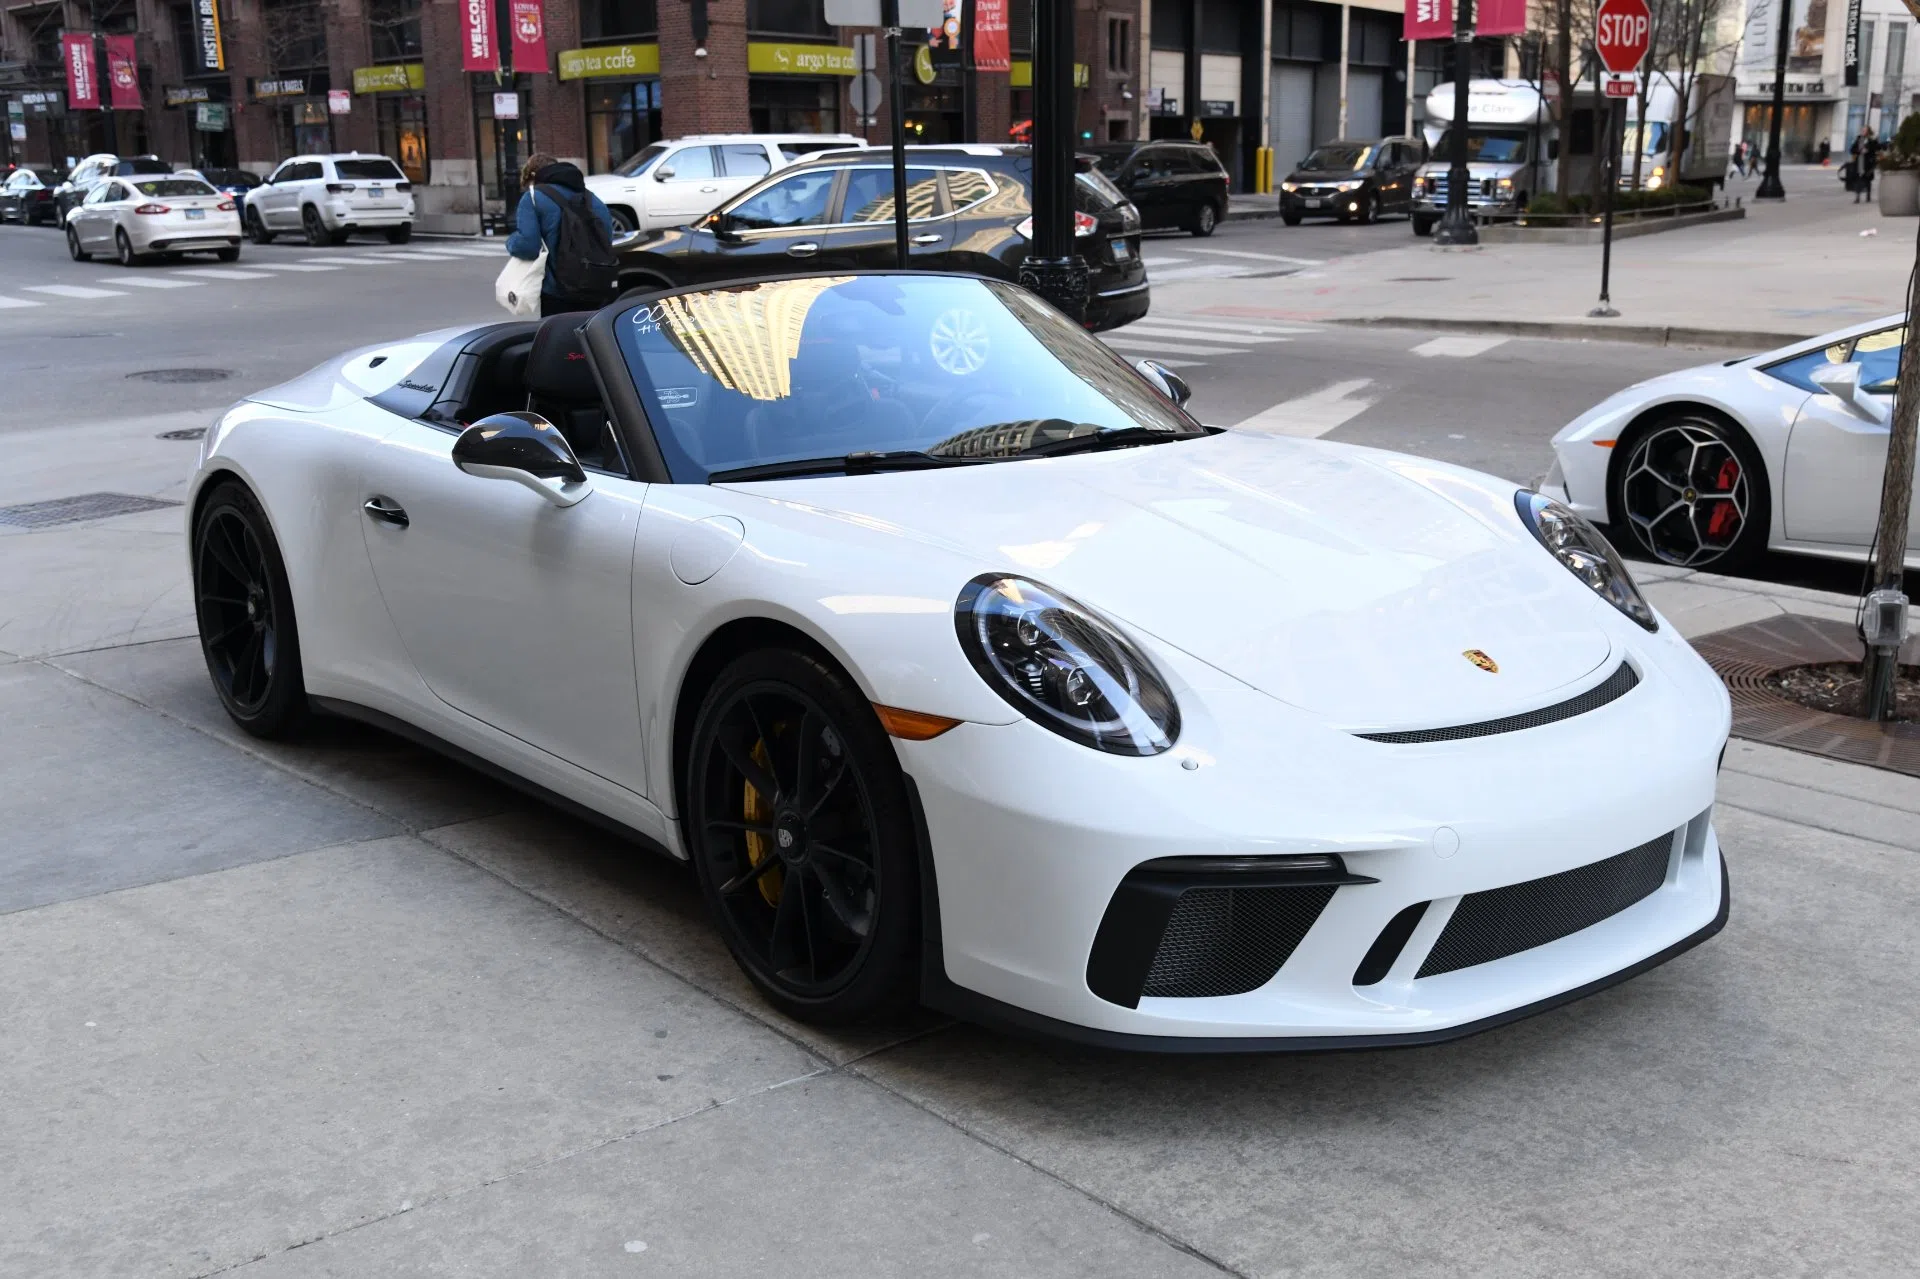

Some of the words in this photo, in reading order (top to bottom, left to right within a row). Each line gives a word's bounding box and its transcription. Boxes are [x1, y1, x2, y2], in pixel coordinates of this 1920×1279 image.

[468, 0, 483, 58] WELCO
[1600, 13, 1648, 48] STOP
[71, 43, 86, 100] WELCOME
[604, 46, 636, 69] café
[796, 52, 824, 72] argo
